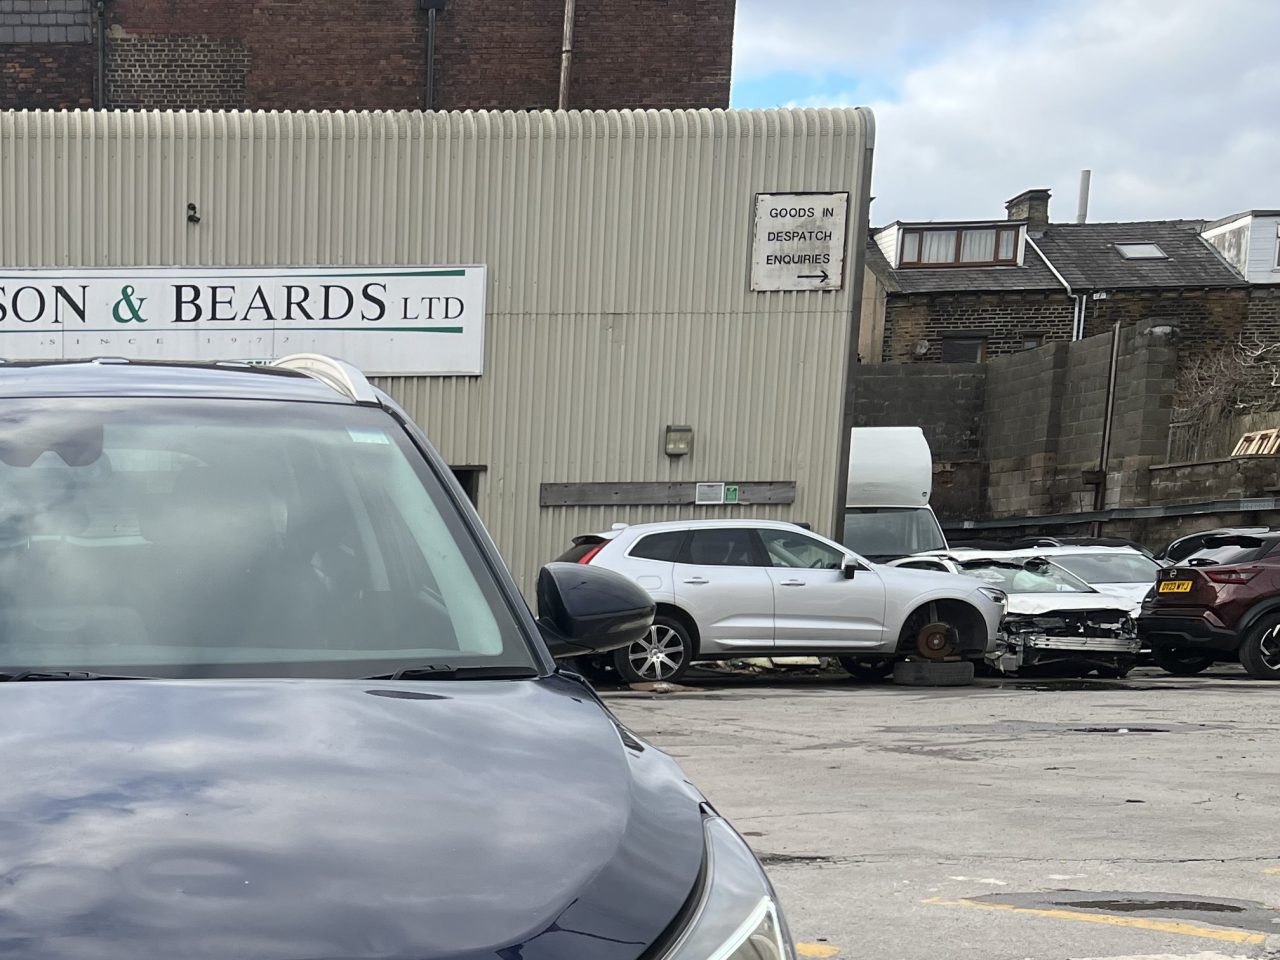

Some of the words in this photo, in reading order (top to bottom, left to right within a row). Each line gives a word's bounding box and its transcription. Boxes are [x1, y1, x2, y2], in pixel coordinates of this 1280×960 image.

[769, 207, 815, 218] GOODS
[822, 207, 834, 217] IN
[767, 231, 832, 242] DESPATCH
[766, 253, 831, 265] ENQUIRIES
[111, 284, 149, 325] &
[170, 282, 388, 323] BEARDS
[400, 296, 465, 320] LTD
[48, 338, 165, 346] SINCE
